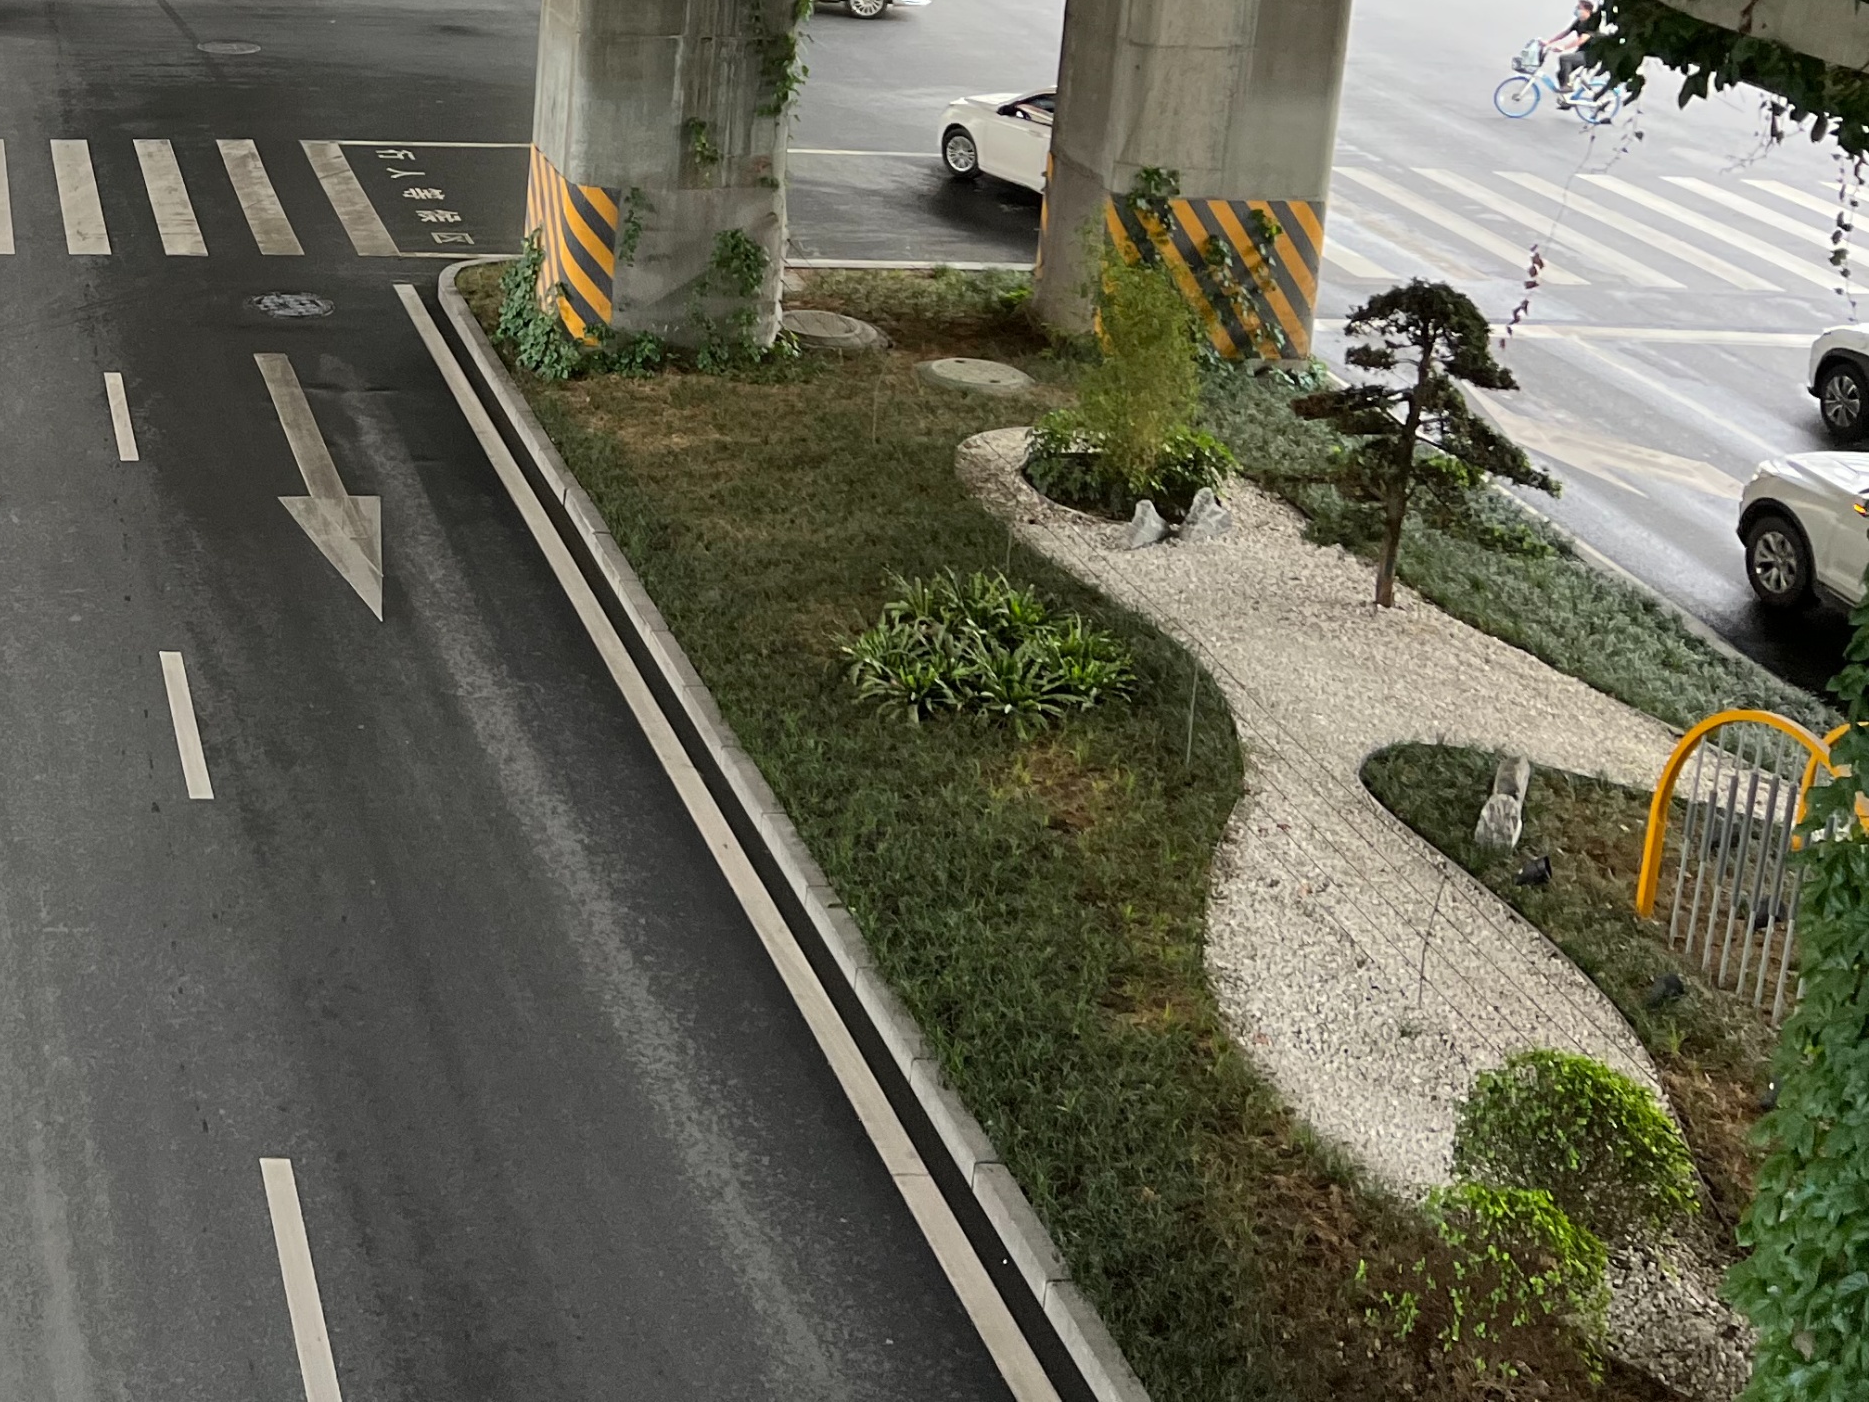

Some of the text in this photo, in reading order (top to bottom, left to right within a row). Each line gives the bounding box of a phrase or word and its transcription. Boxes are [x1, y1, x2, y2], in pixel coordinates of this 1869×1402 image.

[375, 150, 475, 245] 行人等候区
